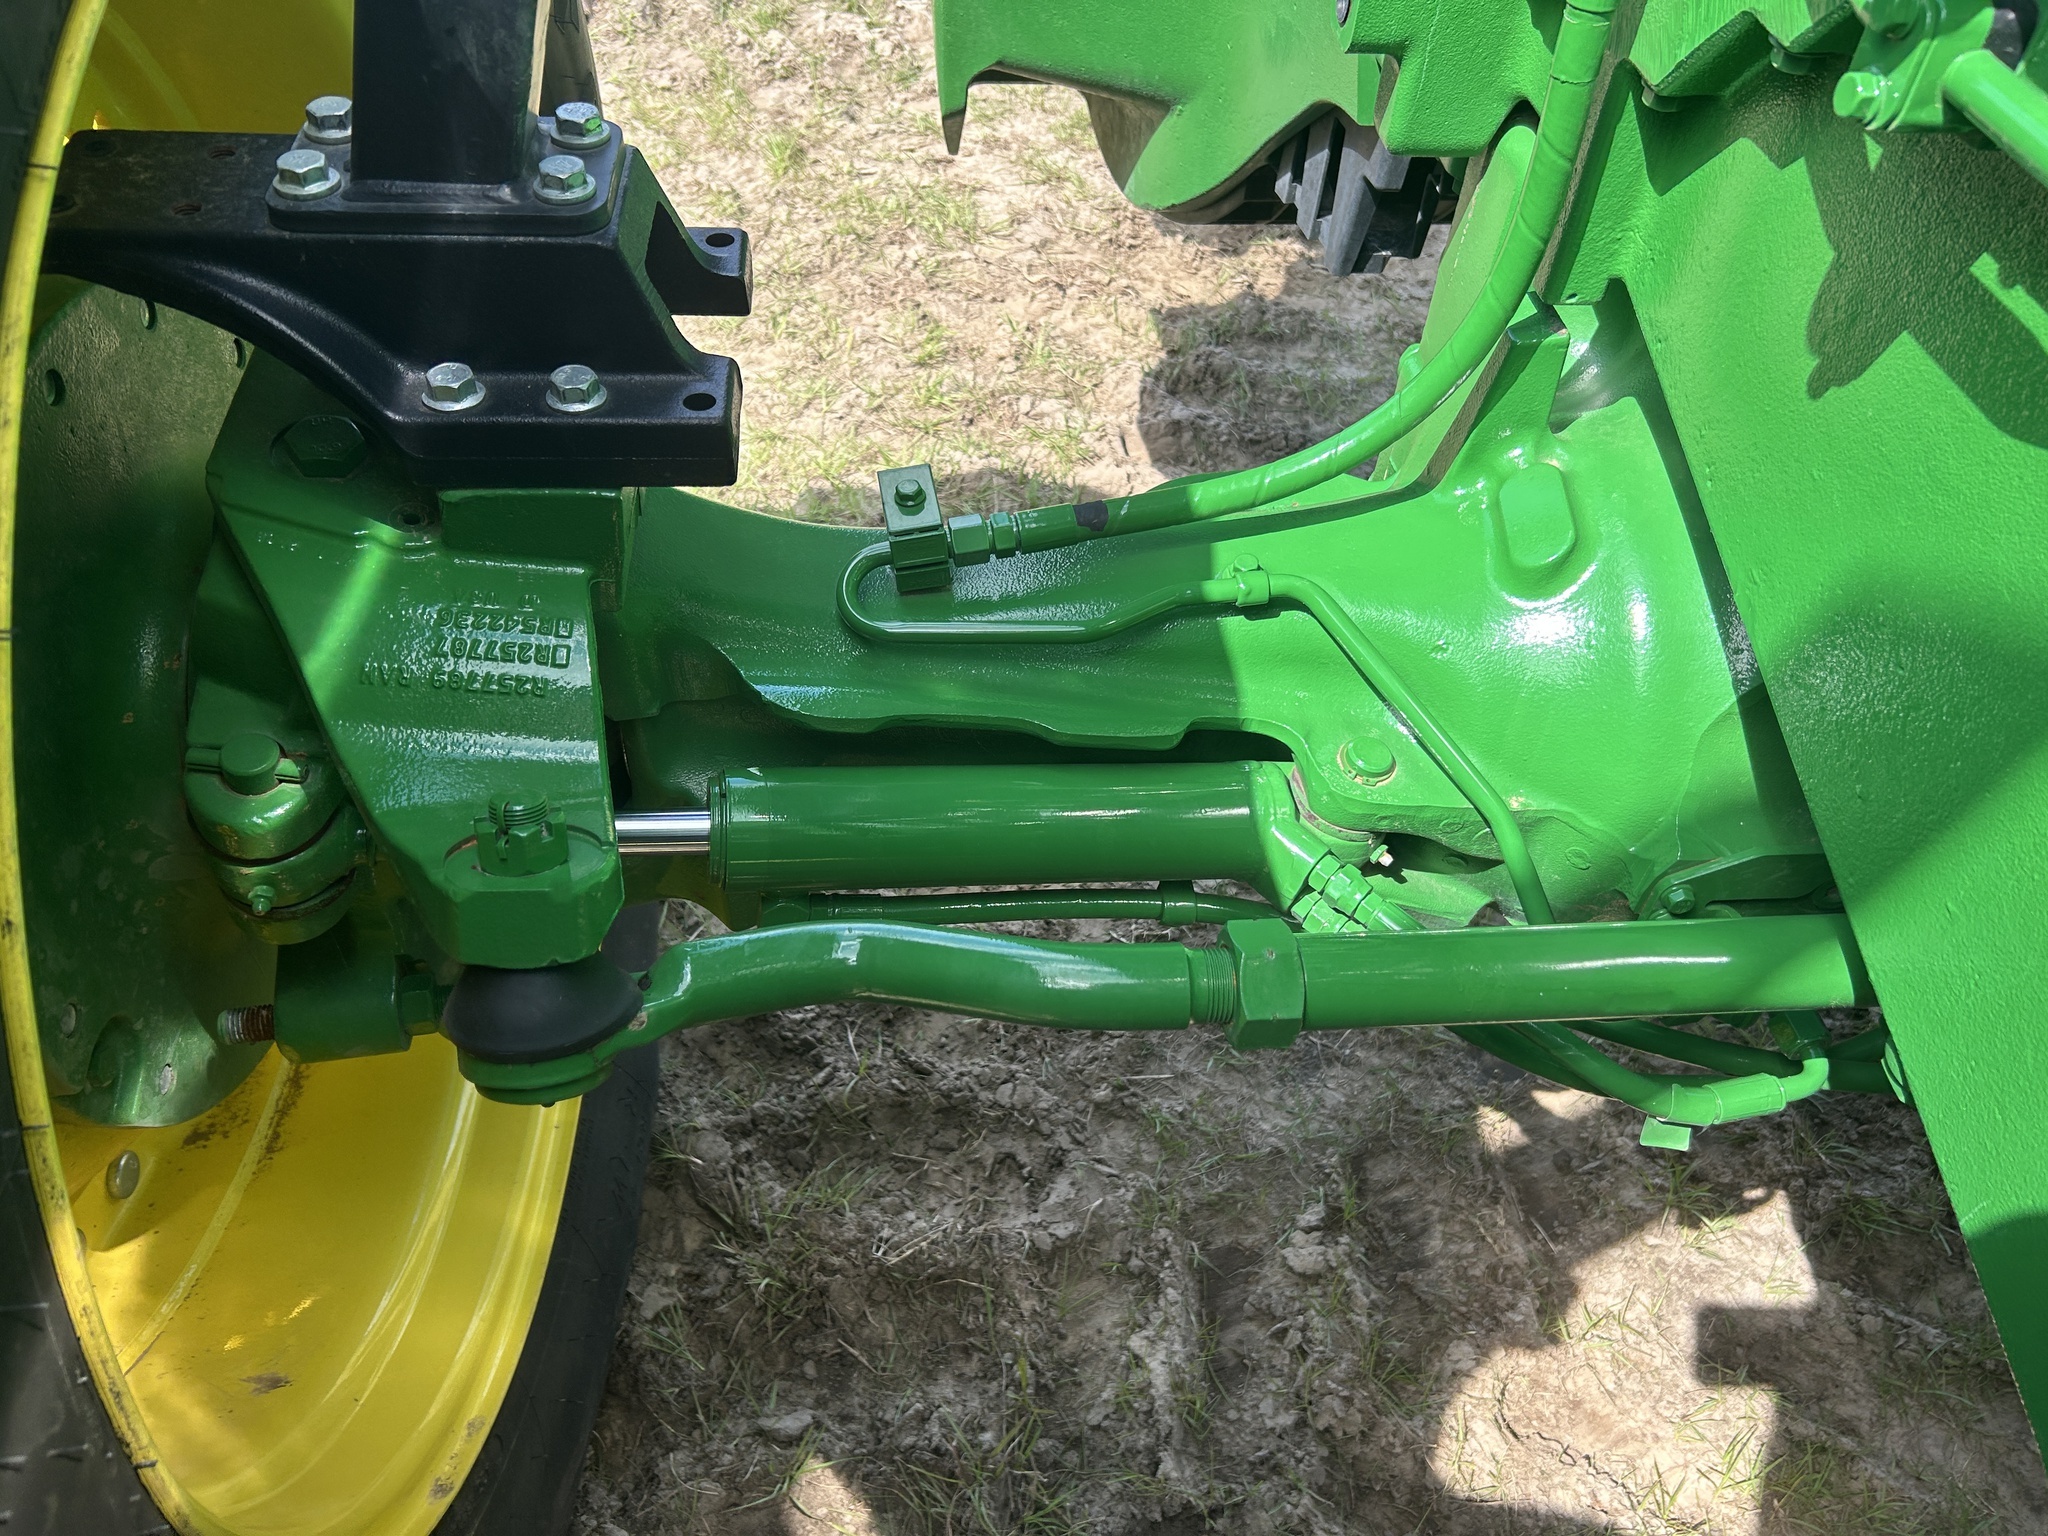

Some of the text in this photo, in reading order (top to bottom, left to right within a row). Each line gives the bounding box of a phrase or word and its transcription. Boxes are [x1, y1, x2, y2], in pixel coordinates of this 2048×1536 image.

[440, 608, 554, 634] R542236
[435, 638, 551, 666] R257787
[361, 663, 547, 697] R257789 RAW
